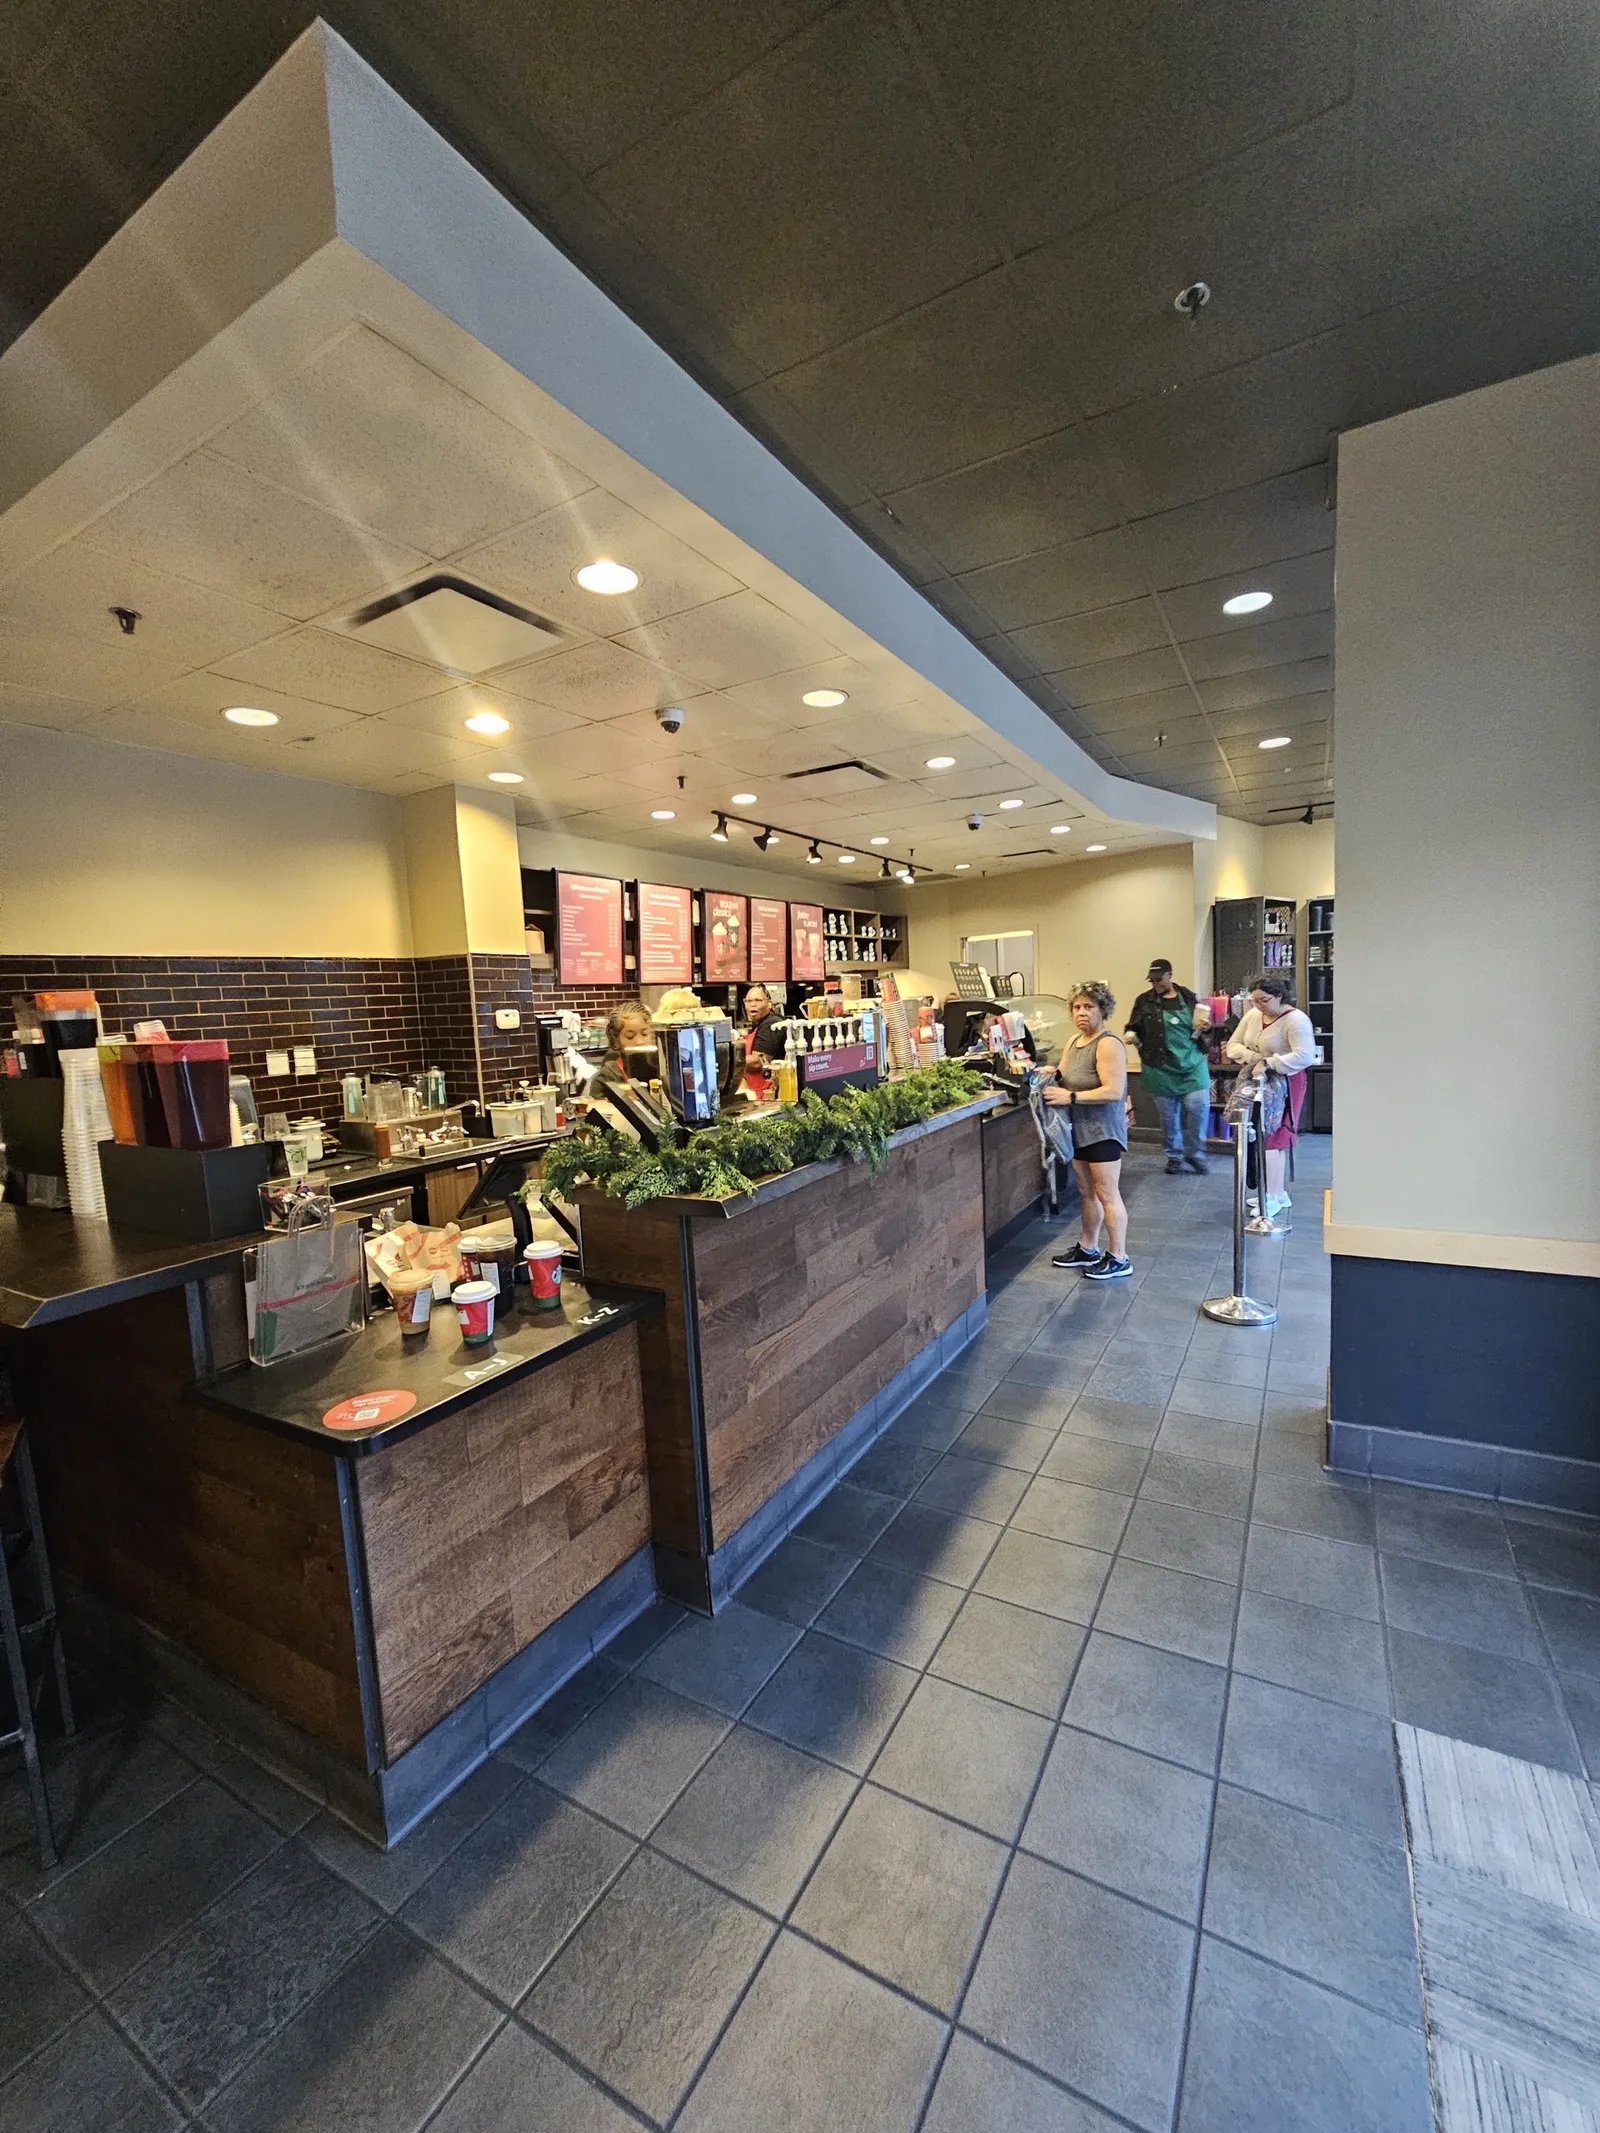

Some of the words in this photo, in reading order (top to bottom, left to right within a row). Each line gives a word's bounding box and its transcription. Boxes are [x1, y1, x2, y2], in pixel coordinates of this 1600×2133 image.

[808, 1055, 820, 1064] Make
[820, 1053, 832, 1062] every
[808, 1064, 816, 1073] sip
